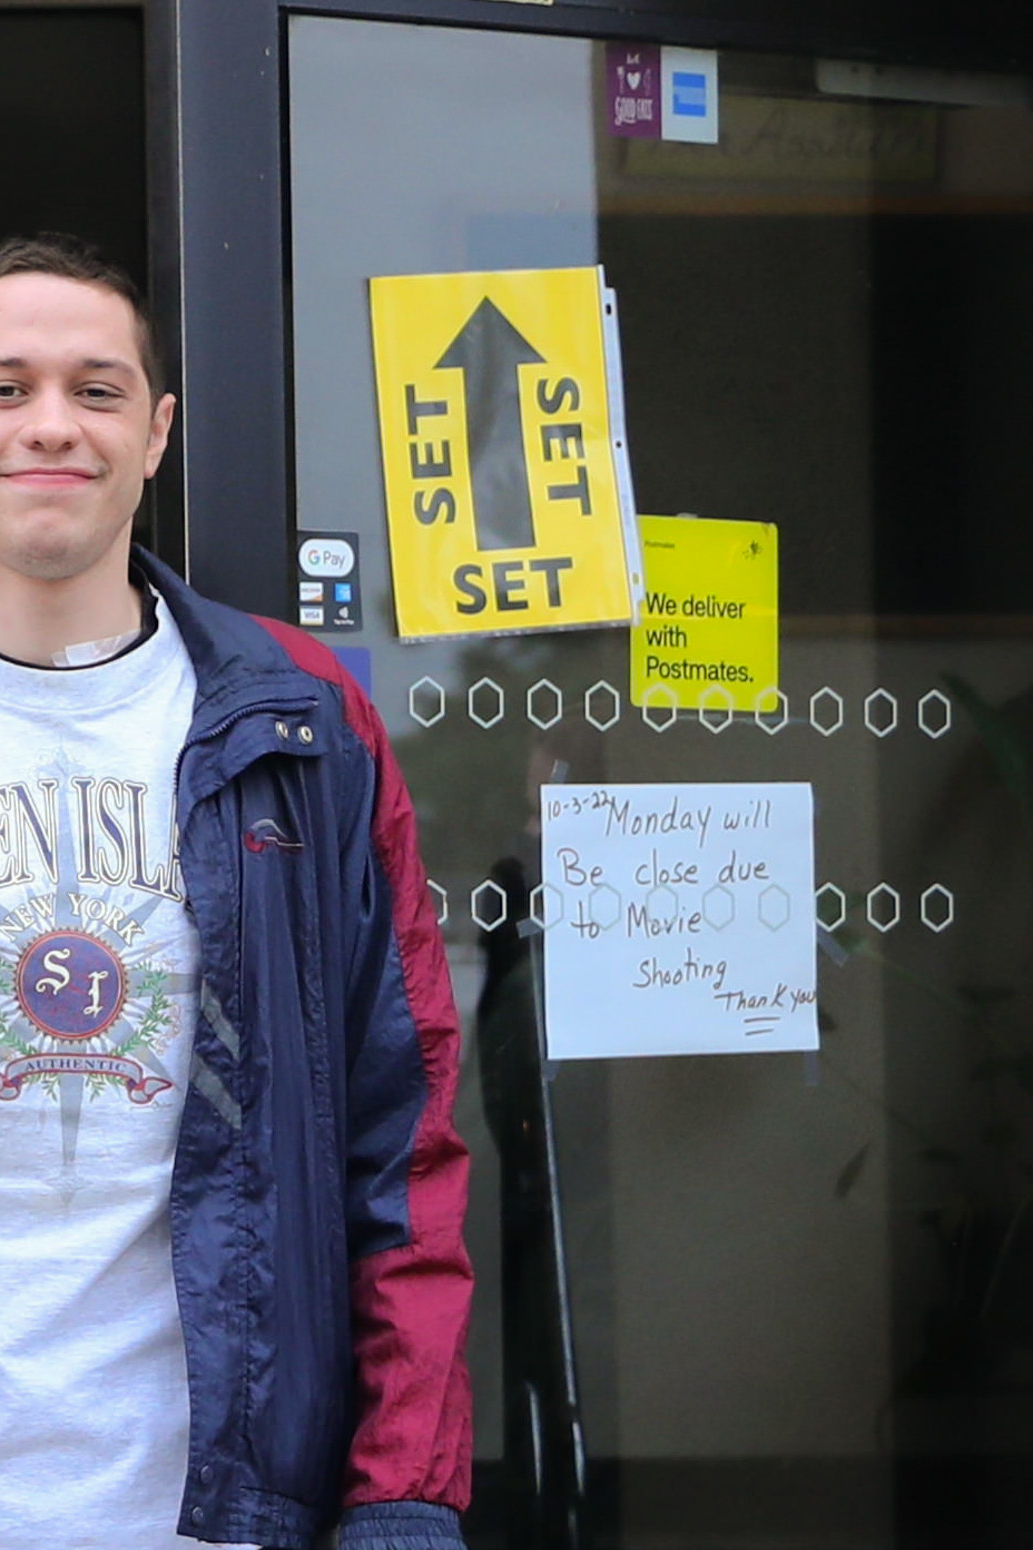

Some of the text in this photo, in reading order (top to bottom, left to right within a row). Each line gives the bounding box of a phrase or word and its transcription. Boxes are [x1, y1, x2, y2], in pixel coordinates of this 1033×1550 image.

[405, 384, 457, 526] SET
[537, 377, 592, 516] SET
[323, 550, 346, 569] Pay
[453, 557, 573, 615] SET
[646, 592, 745, 619] We deliver
[647, 625, 688, 647] with
[647, 655, 754, 683] Postmates.
[605, 796, 712, 848] Monday
[722, 799, 772, 830] will
[557, 847, 770, 886] Be close due
[67, 892, 145, 947] YORK
[570, 900, 702, 939] to Movie
[35, 948, 71, 995] S
[25, 1057, 128, 1073] AUTHENTIC
